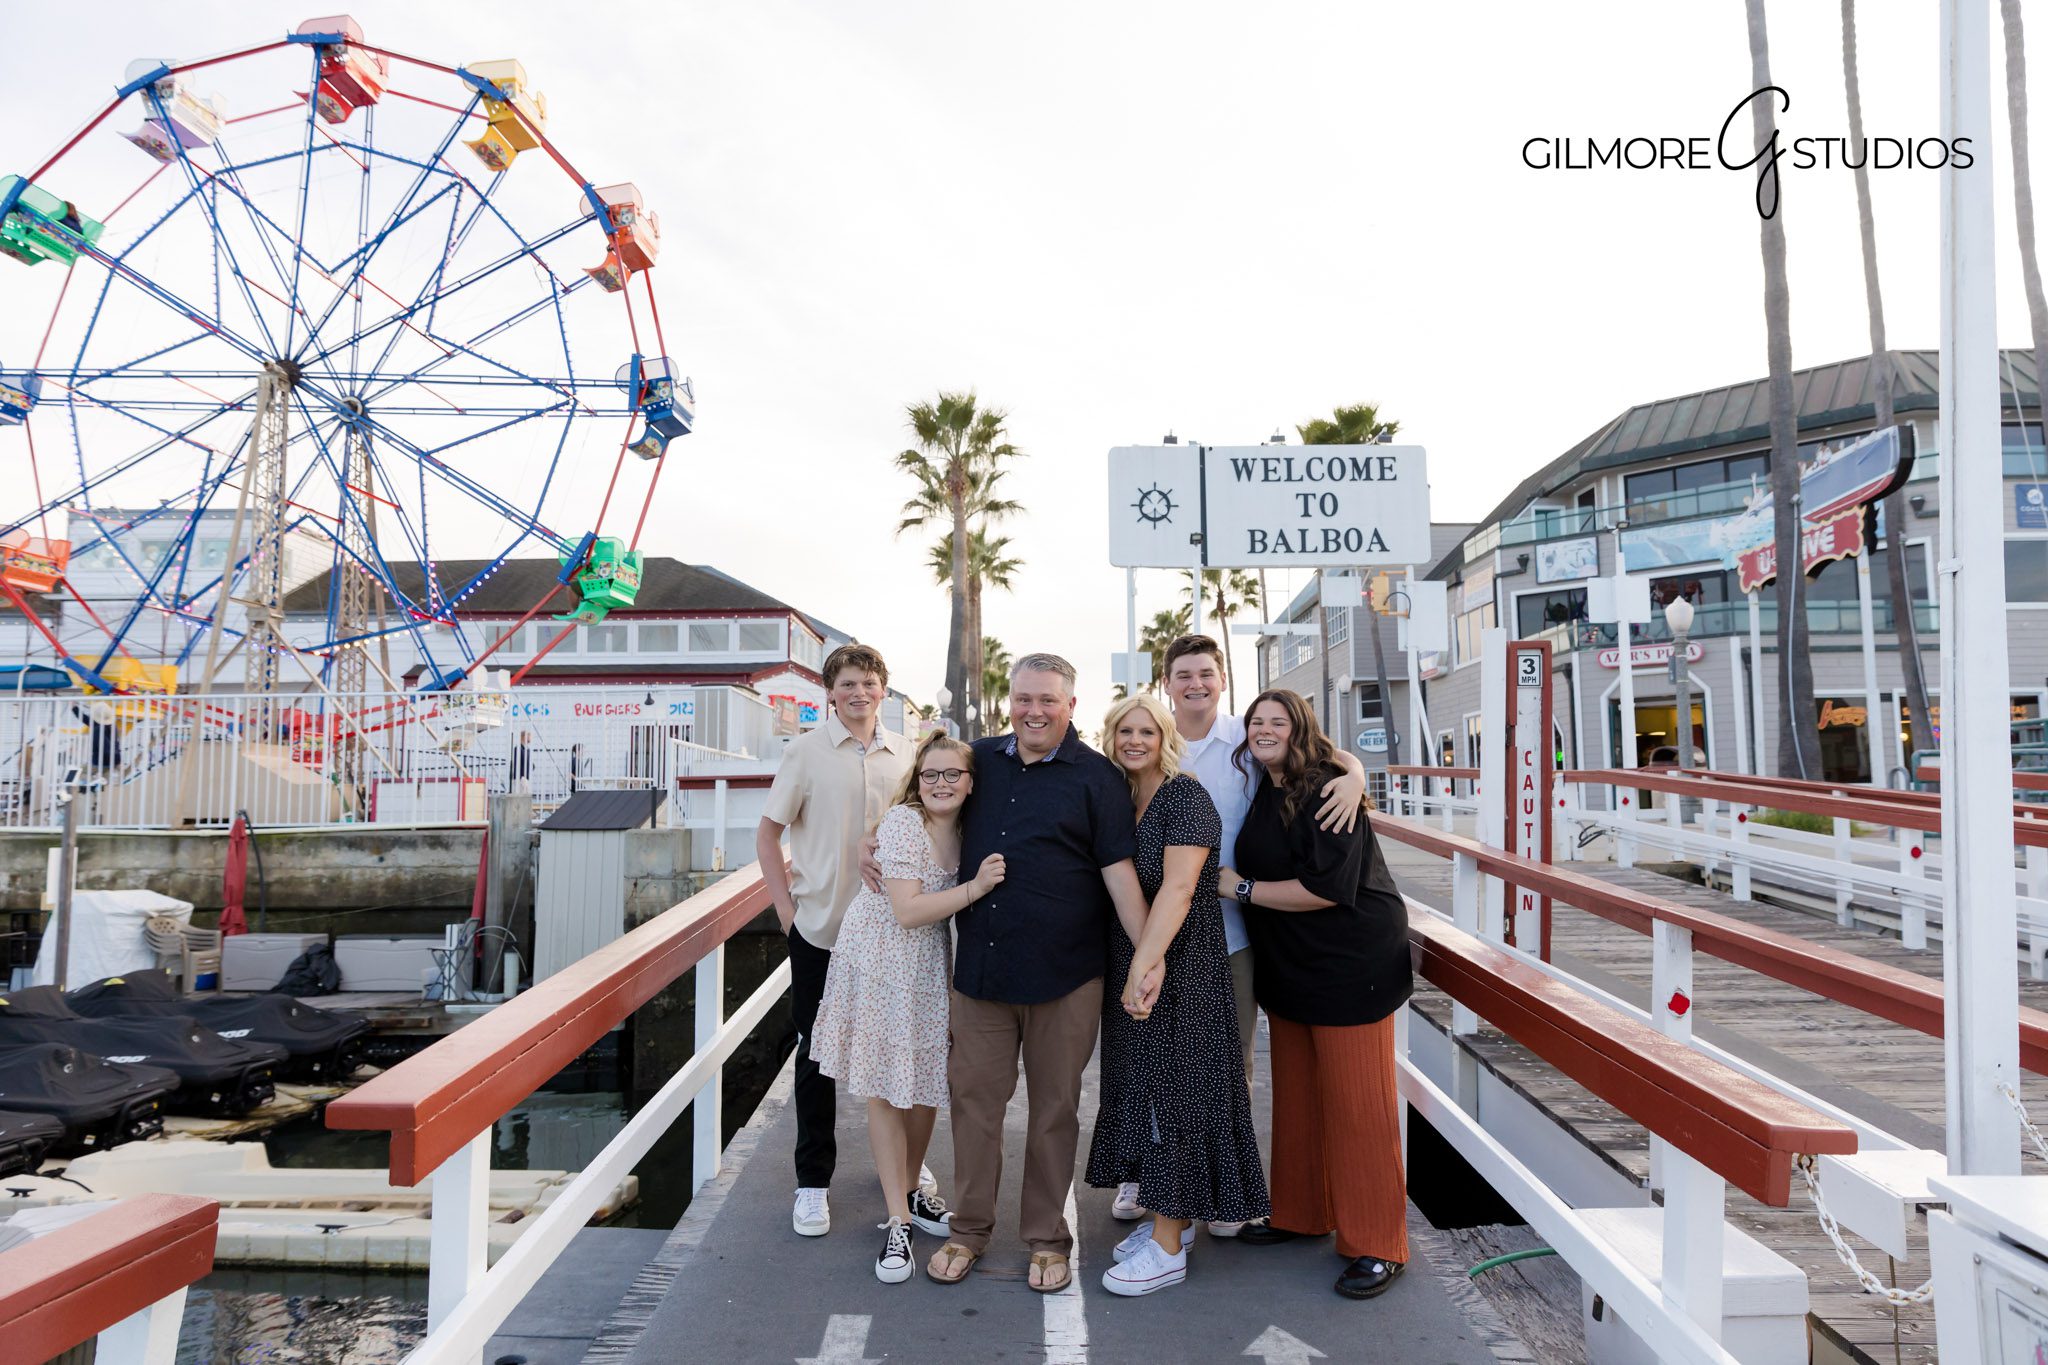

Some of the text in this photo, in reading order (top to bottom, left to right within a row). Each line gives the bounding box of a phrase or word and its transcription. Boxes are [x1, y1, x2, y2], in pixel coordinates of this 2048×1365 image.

[1230, 456, 1397, 482] WELCOME
[1295, 492, 1339, 518] TO
[1247, 527, 1390, 554] BALBOA
[1522, 658, 1536, 675] 3
[1521, 676, 1537, 684] MPH
[1523, 751, 1533, 910] CAUTIN
